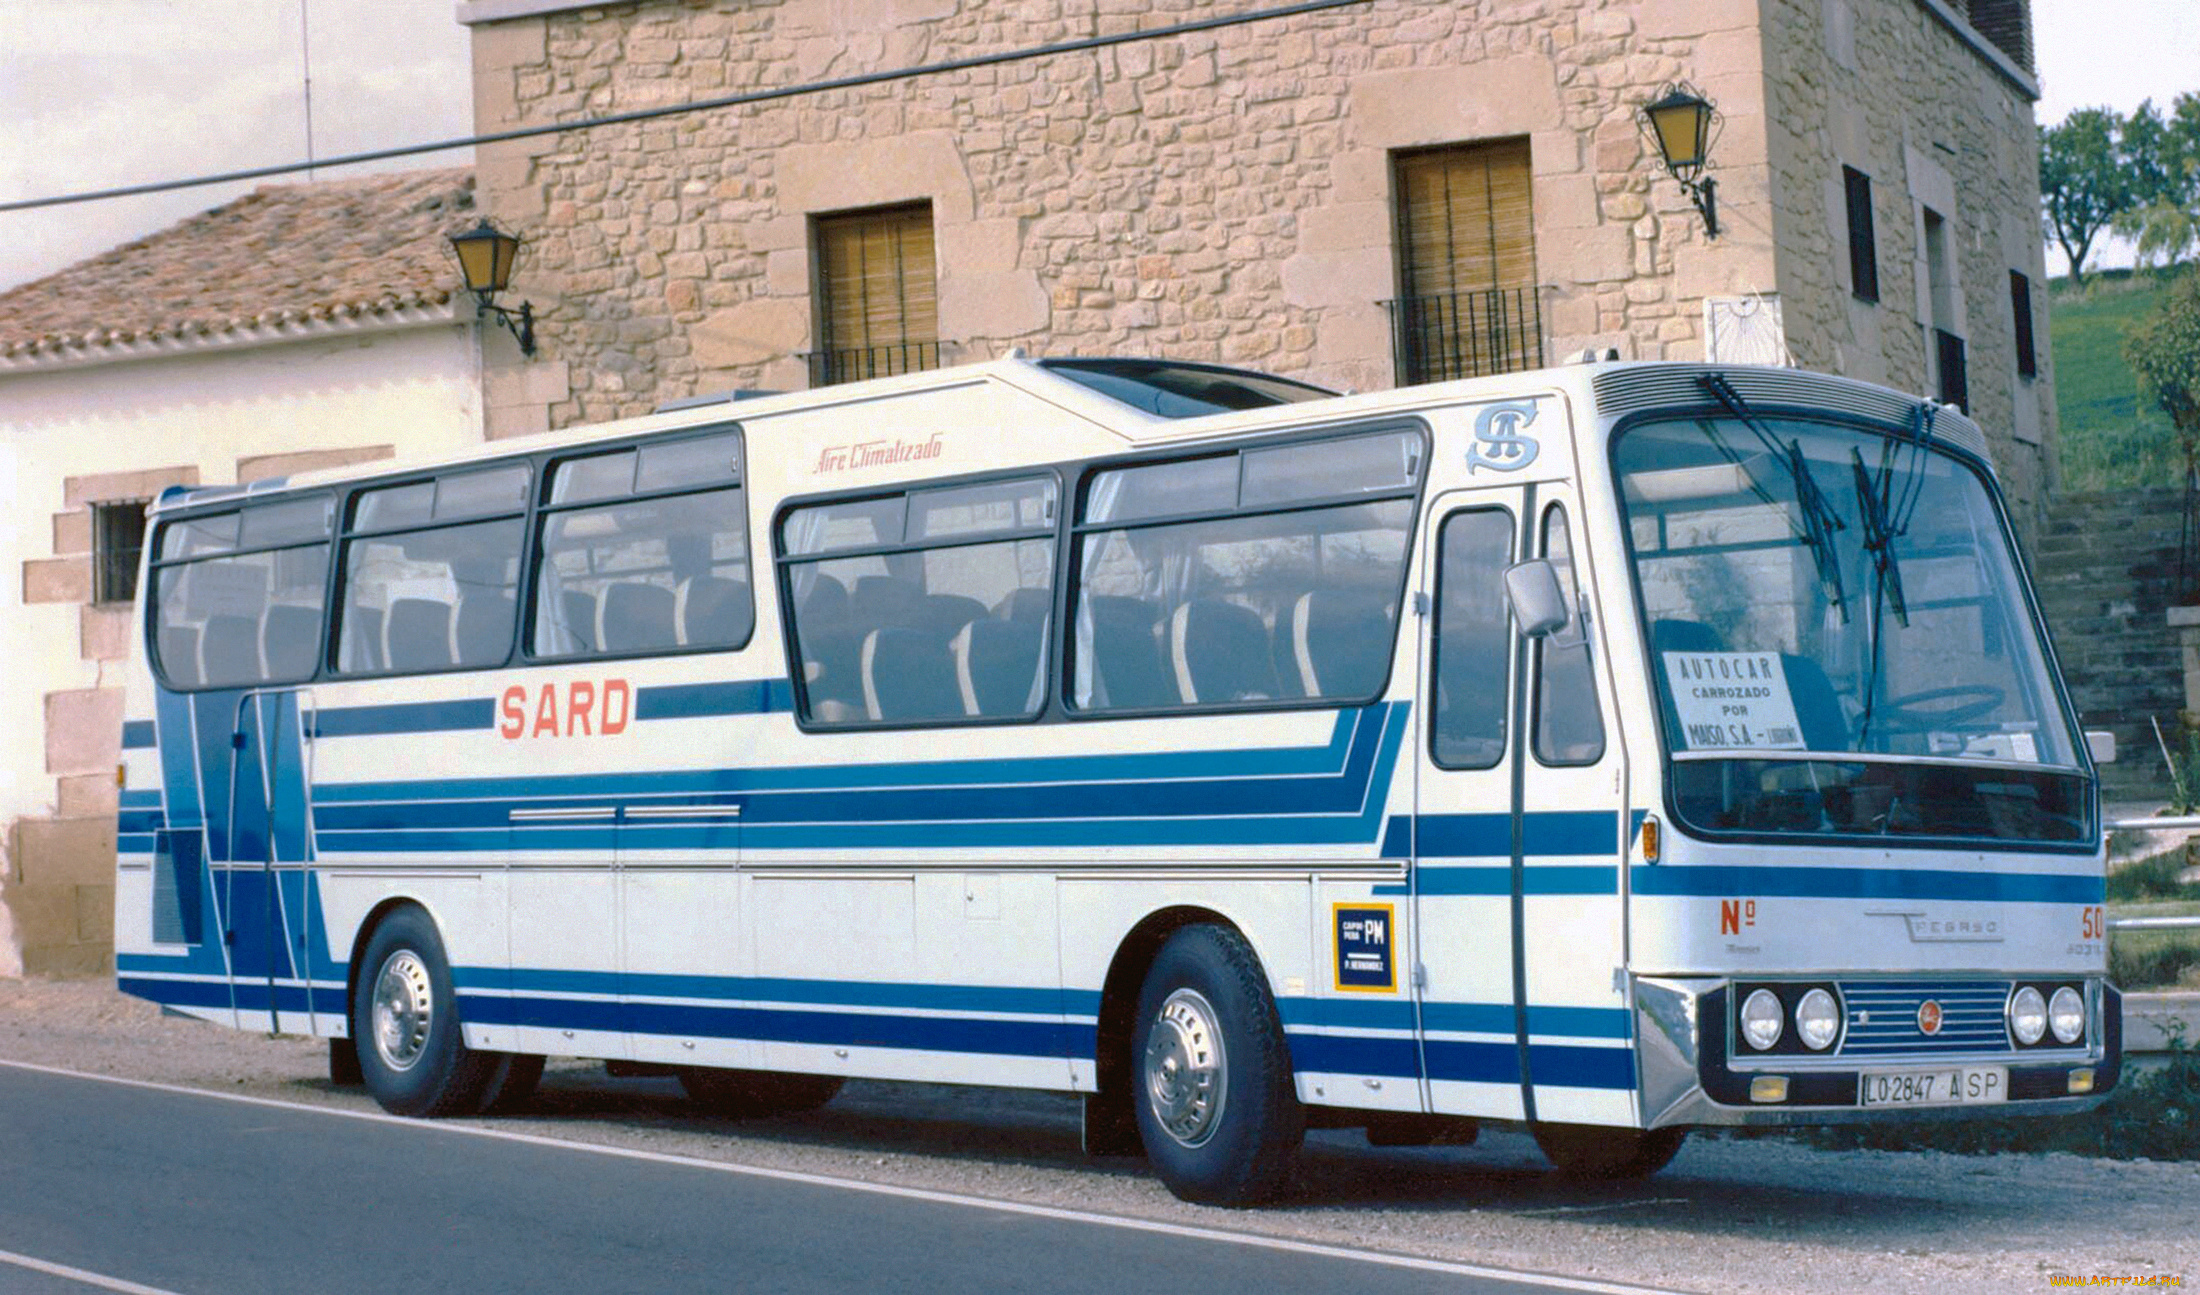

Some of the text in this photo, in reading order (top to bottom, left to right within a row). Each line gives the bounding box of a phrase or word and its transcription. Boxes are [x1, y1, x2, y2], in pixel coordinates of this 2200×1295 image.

[812, 445, 848, 475] Aire
[1679, 657, 1772, 680] AUTOCAR
[1692, 687, 1771, 698] CARROZADO
[501, 679, 630, 740] SARD
[1722, 705, 1748, 716] POR
[1365, 919, 1384, 945] PM
[1914, 920, 1997, 933] PEGASO
[2082, 906, 2103, 939] 50
[1968, 1073, 1998, 1098] SP
